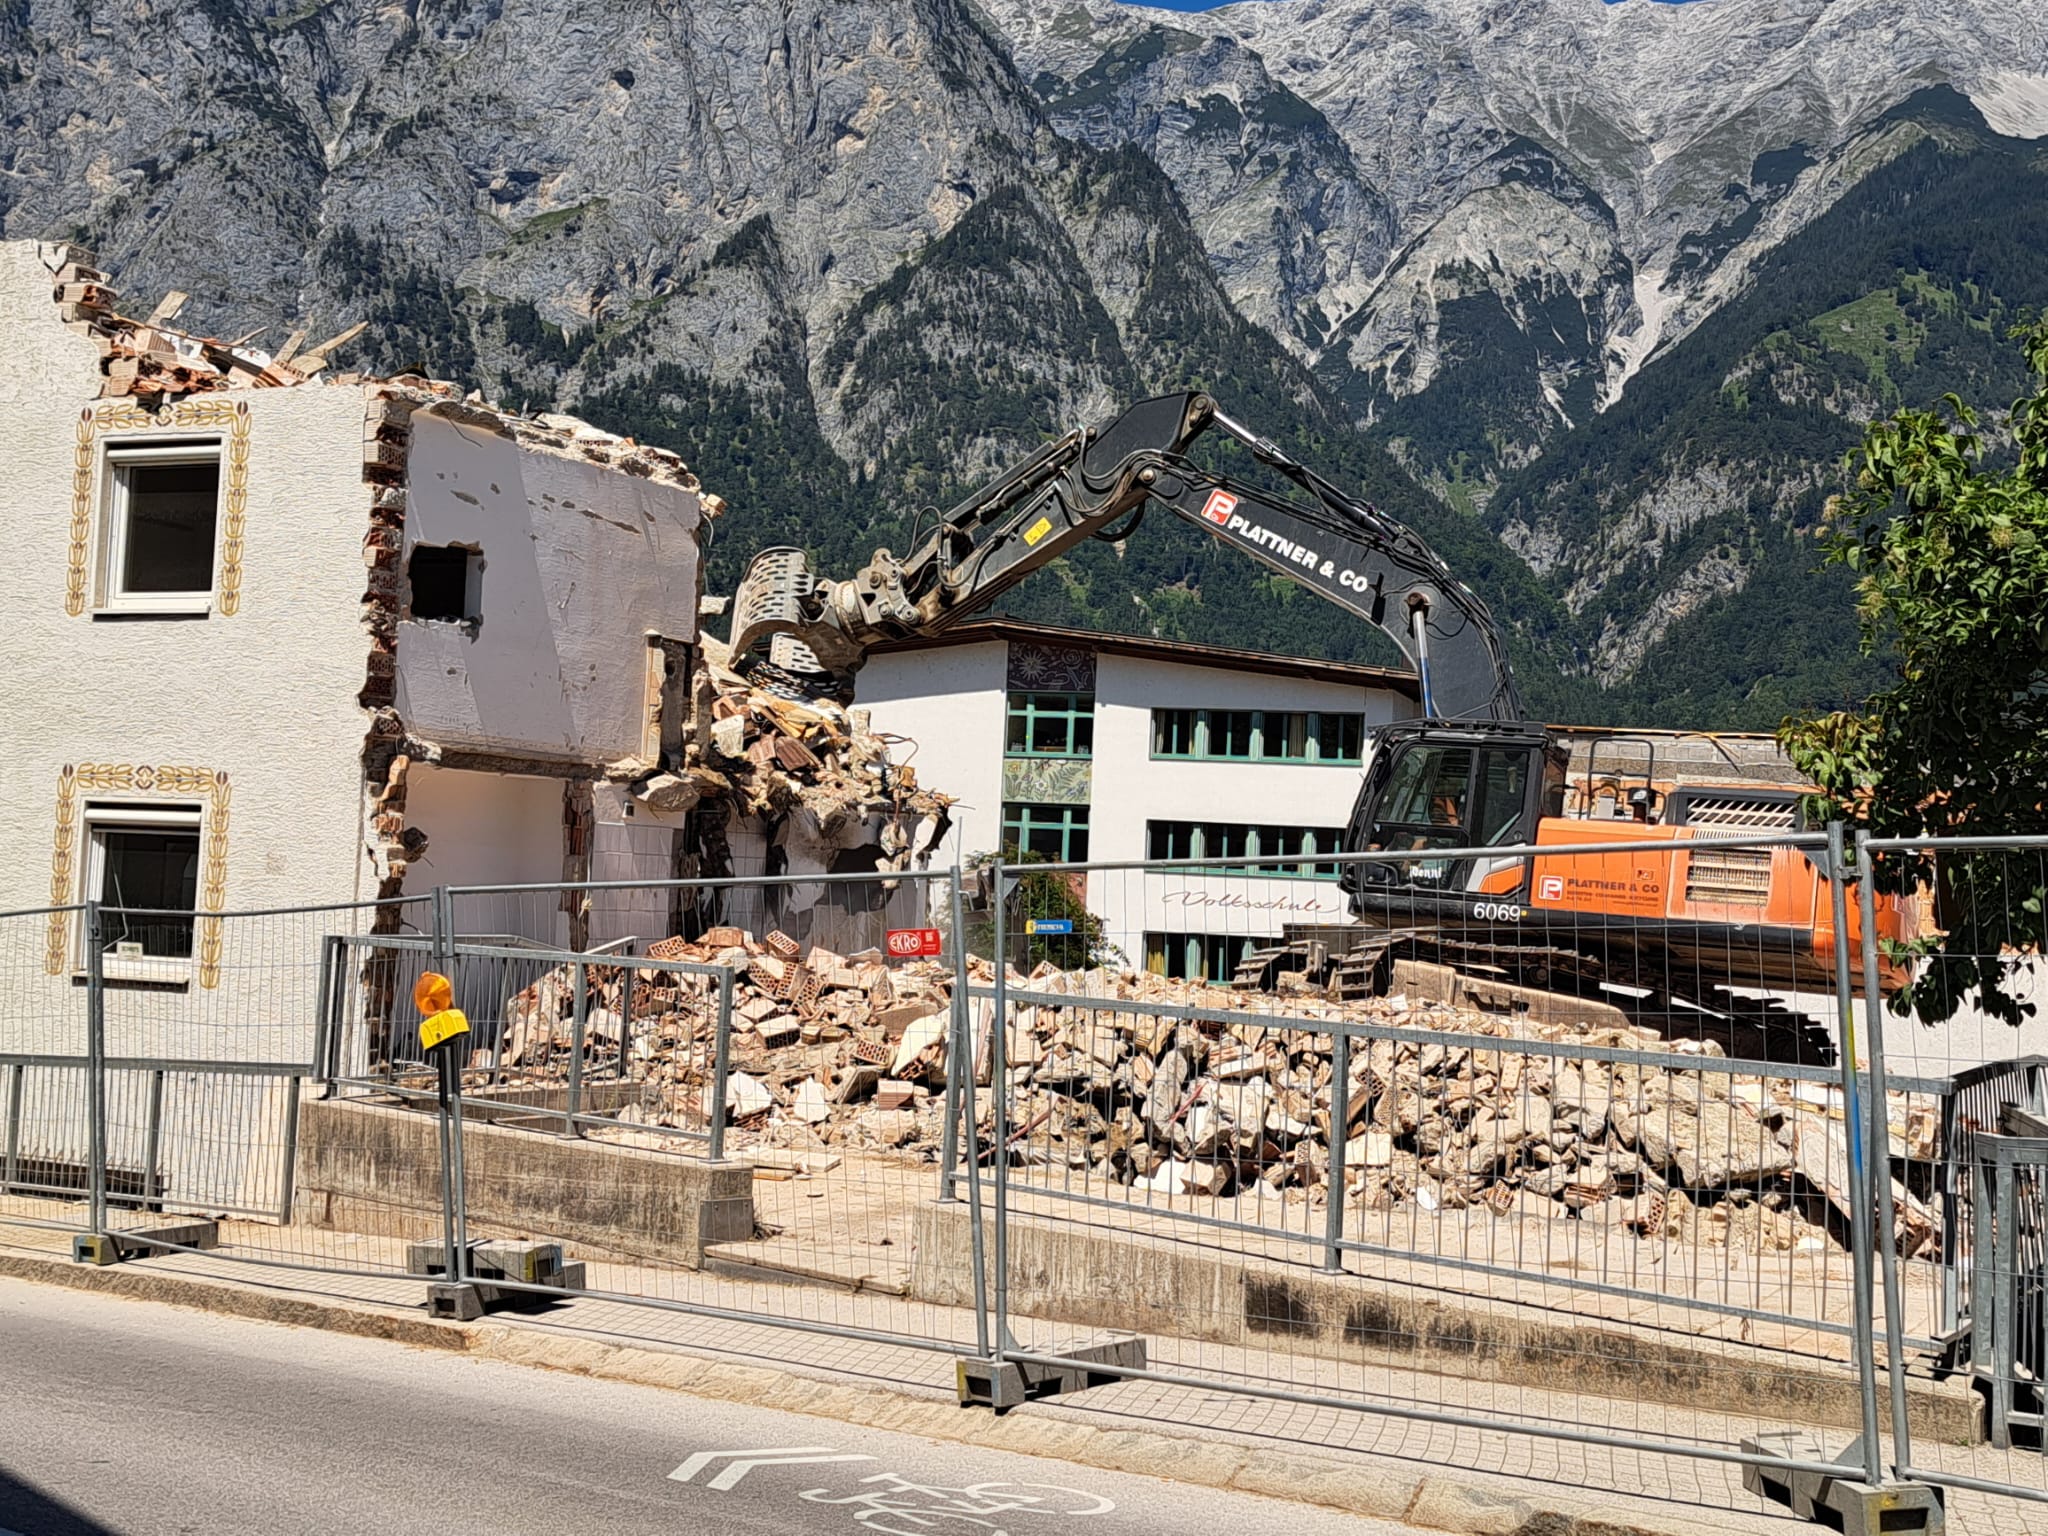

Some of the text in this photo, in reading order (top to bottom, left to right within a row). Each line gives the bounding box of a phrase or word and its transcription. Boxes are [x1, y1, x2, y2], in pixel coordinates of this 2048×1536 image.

[1227, 514, 1319, 570] PLATTNER
[1319, 560, 1335, 579] &
[1339, 569, 1369, 593] CO
[1567, 878, 1626, 891] PLATTNER
[1629, 883, 1638, 893] &
[1642, 884, 1660, 894] CO
[1161, 890, 1341, 914] Volksschule
[1473, 902, 1521, 922] 6069
[890, 934, 919, 952] EKRO
